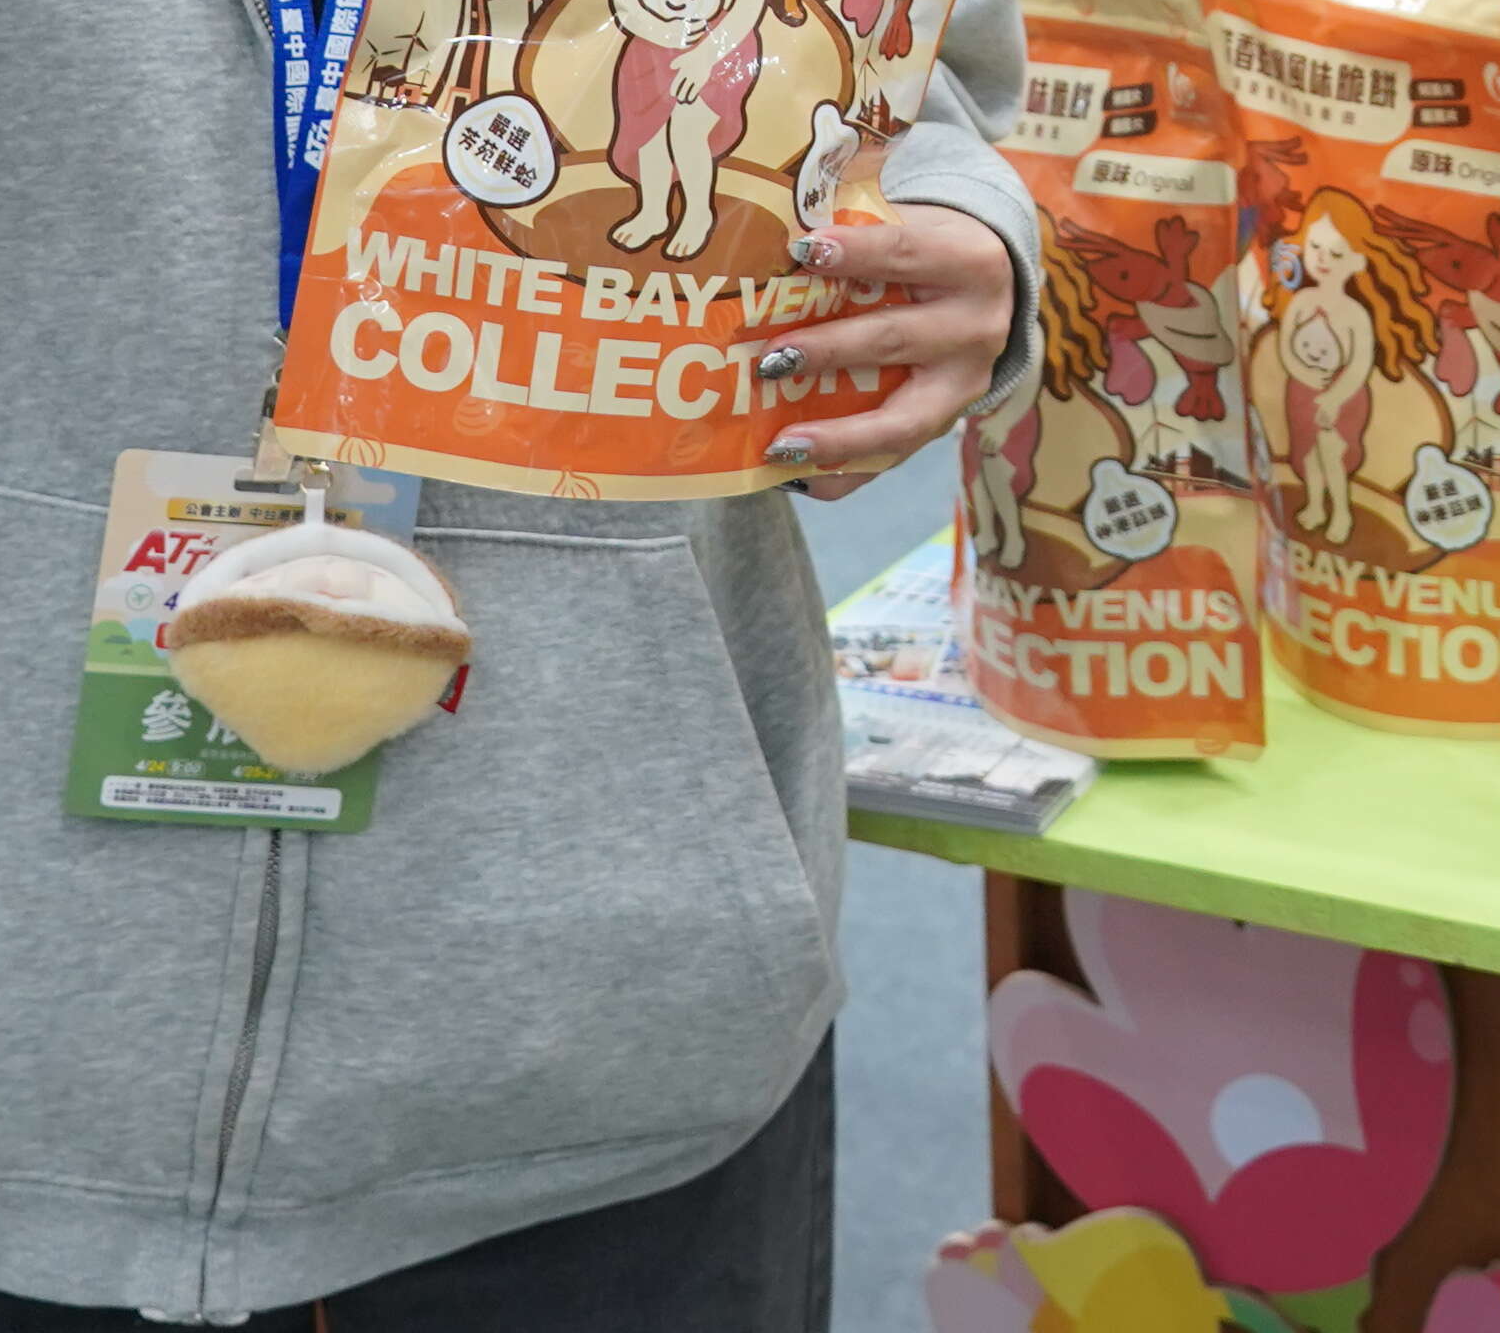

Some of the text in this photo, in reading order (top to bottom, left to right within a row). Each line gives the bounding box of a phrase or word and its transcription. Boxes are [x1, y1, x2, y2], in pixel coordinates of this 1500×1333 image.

[1409, 149, 1454, 178] 原味
[347, 227, 730, 329] WHITE BAY
[1290, 546, 1365, 597] BAY
[1055, 589, 1242, 632] VENUS
